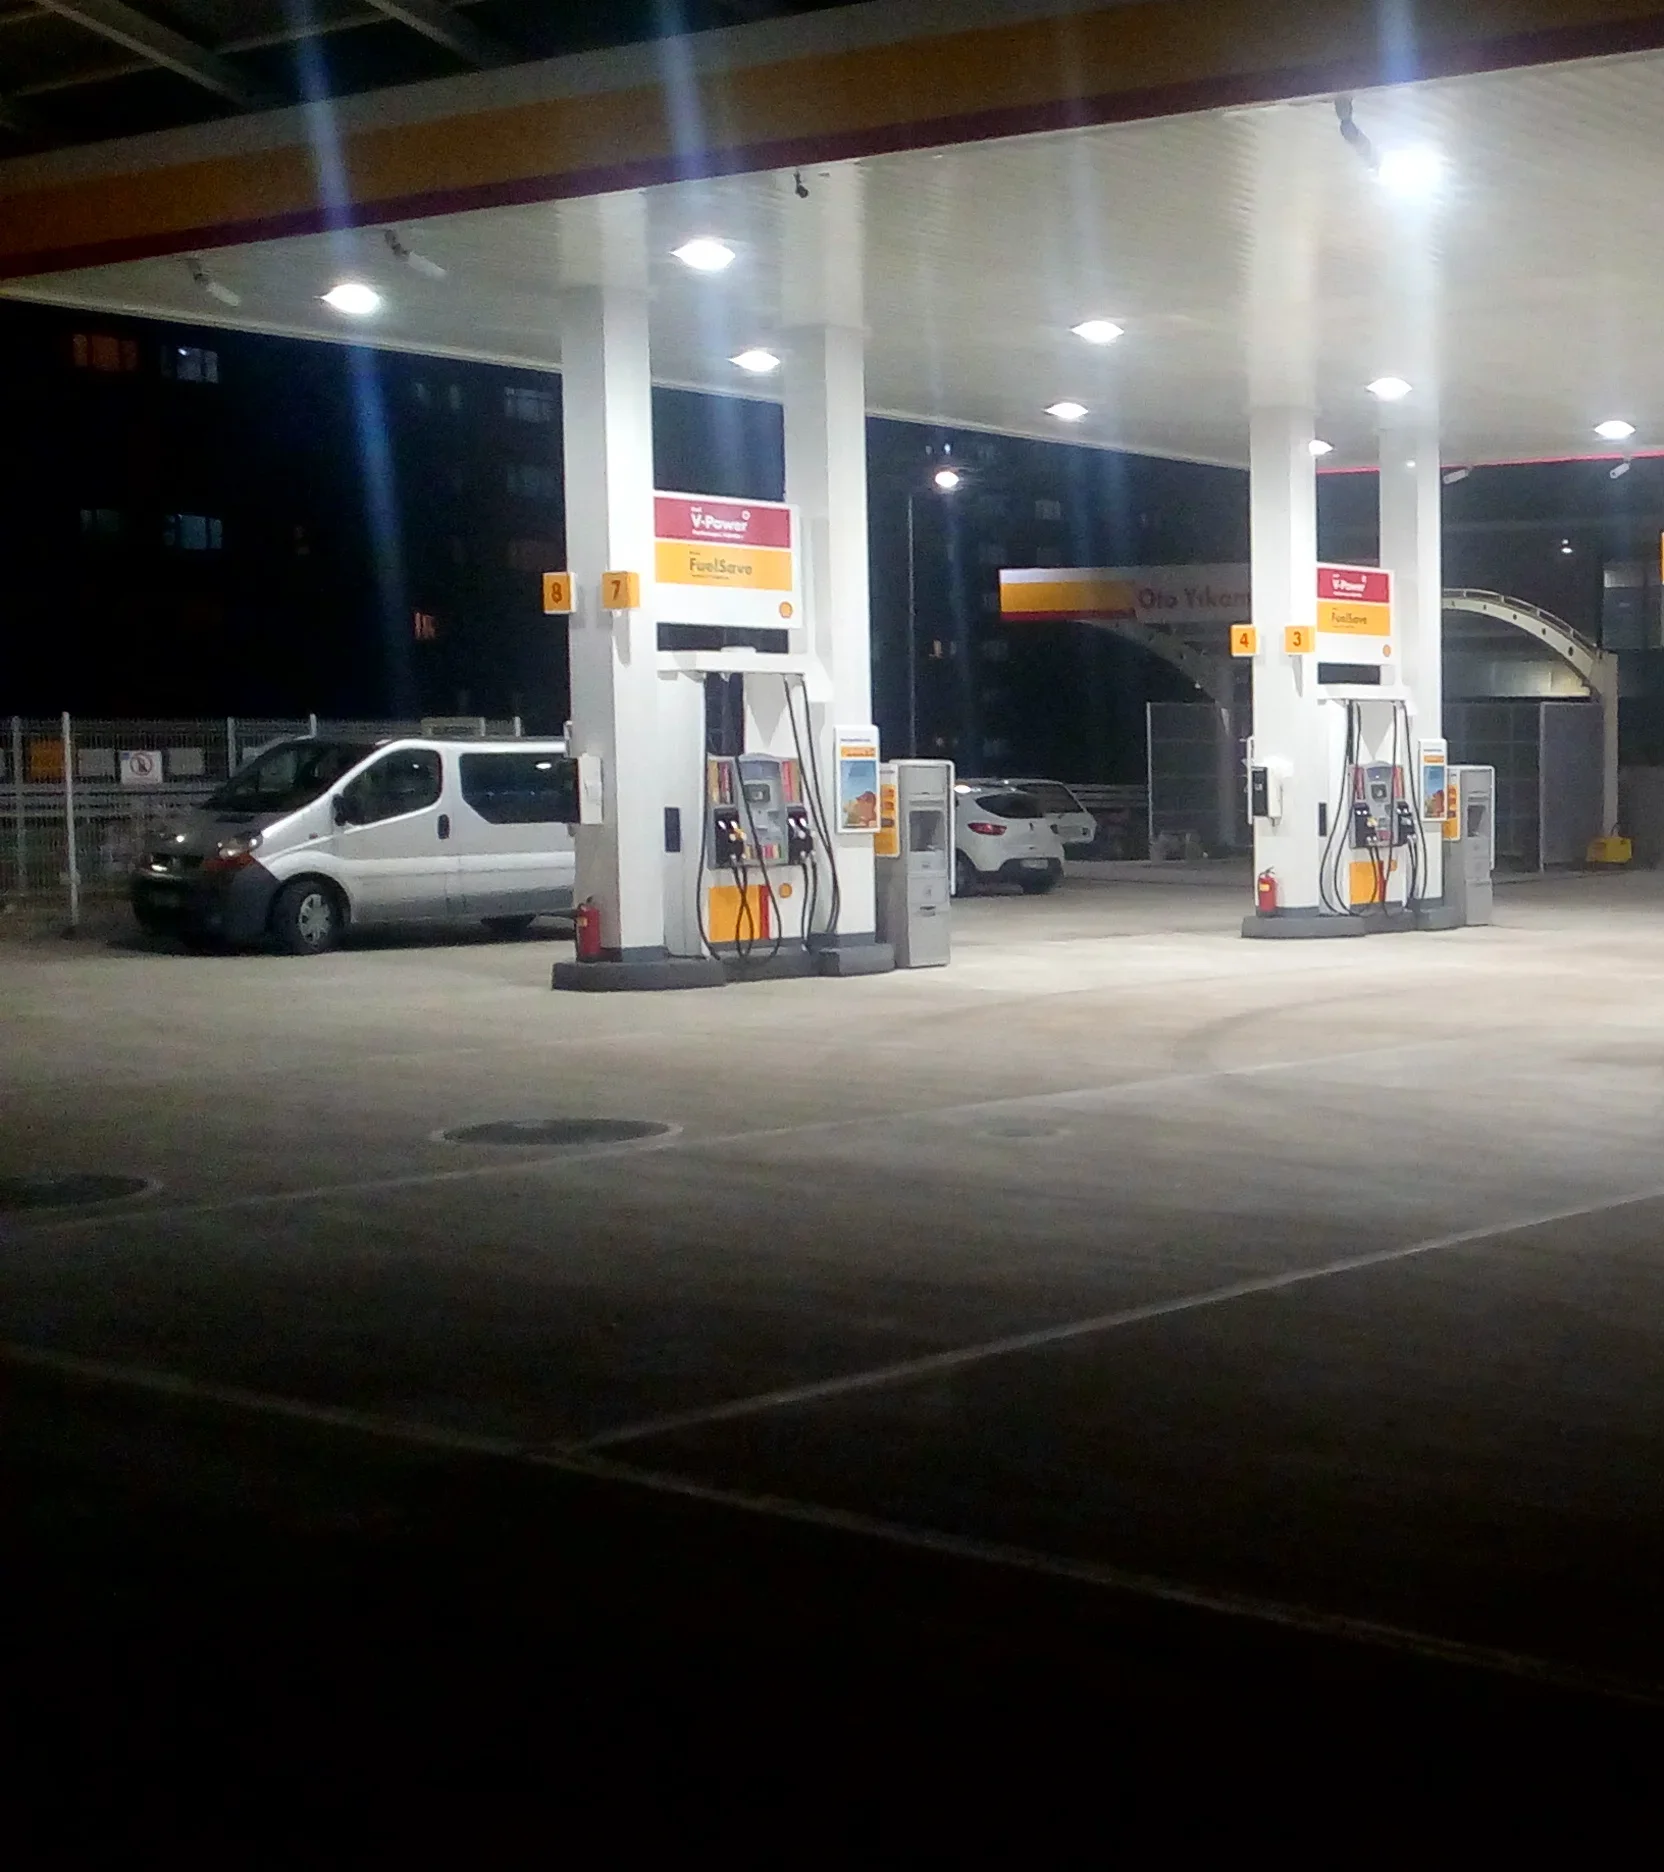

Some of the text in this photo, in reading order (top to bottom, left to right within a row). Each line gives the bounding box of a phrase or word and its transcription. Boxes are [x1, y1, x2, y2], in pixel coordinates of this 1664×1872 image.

[690, 512, 748, 532] V-Power
[689, 557, 752, 576] FuelSave
[551, 581, 563, 604] 8
[611, 579, 621, 600] 7
[1138, 587, 1178, 609] Oto
[1239, 632, 1249, 647] 4
[1293, 631, 1302, 647] 3
